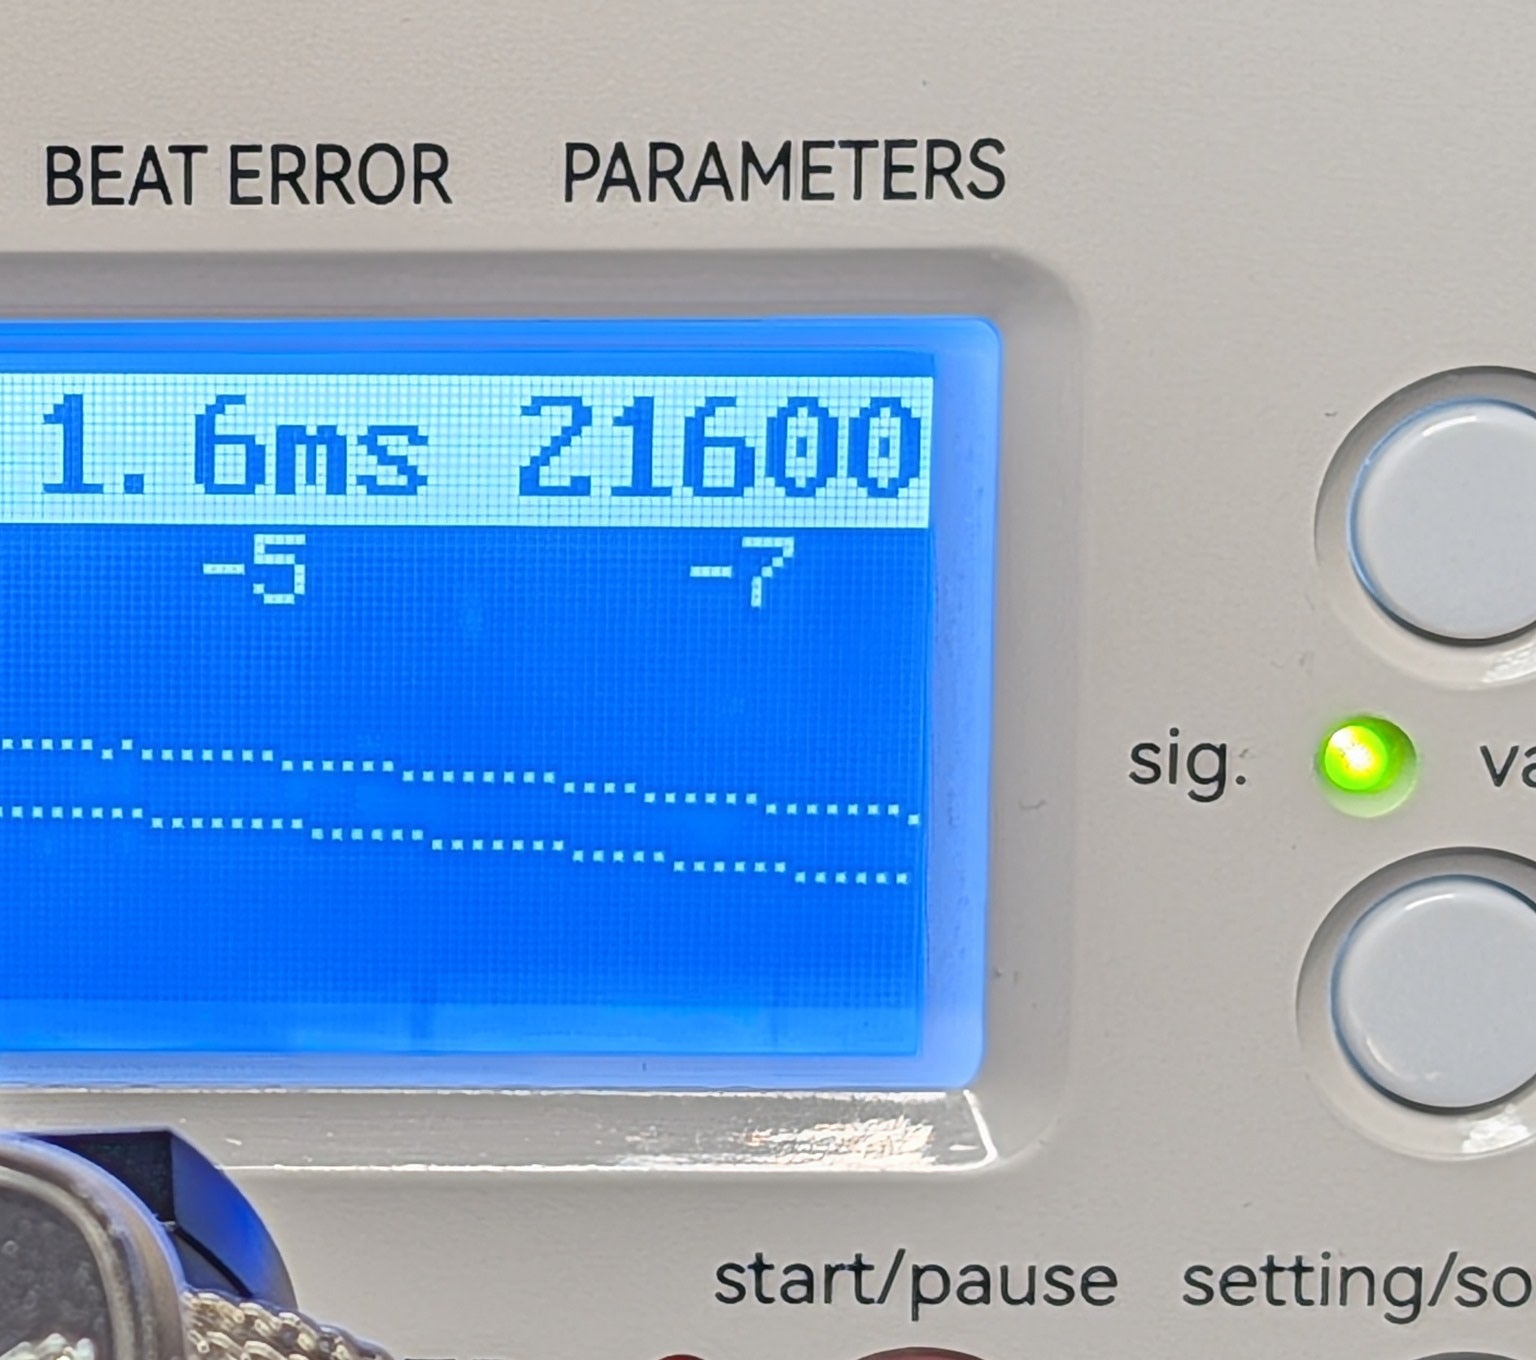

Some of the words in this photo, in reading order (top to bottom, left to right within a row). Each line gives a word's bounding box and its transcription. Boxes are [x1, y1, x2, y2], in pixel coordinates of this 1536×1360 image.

[46, 144, 209, 207] BEAT
[229, 142, 453, 206] ERROR
[564, 137, 1006, 203] PARAMETERS
[518, 395, 922, 500] 21600
[203, 534, 306, 604] -5
[691, 537, 794, 607] -7
[1129, 727, 1247, 803] sig.
[714, 1248, 1118, 1322] start/pause
